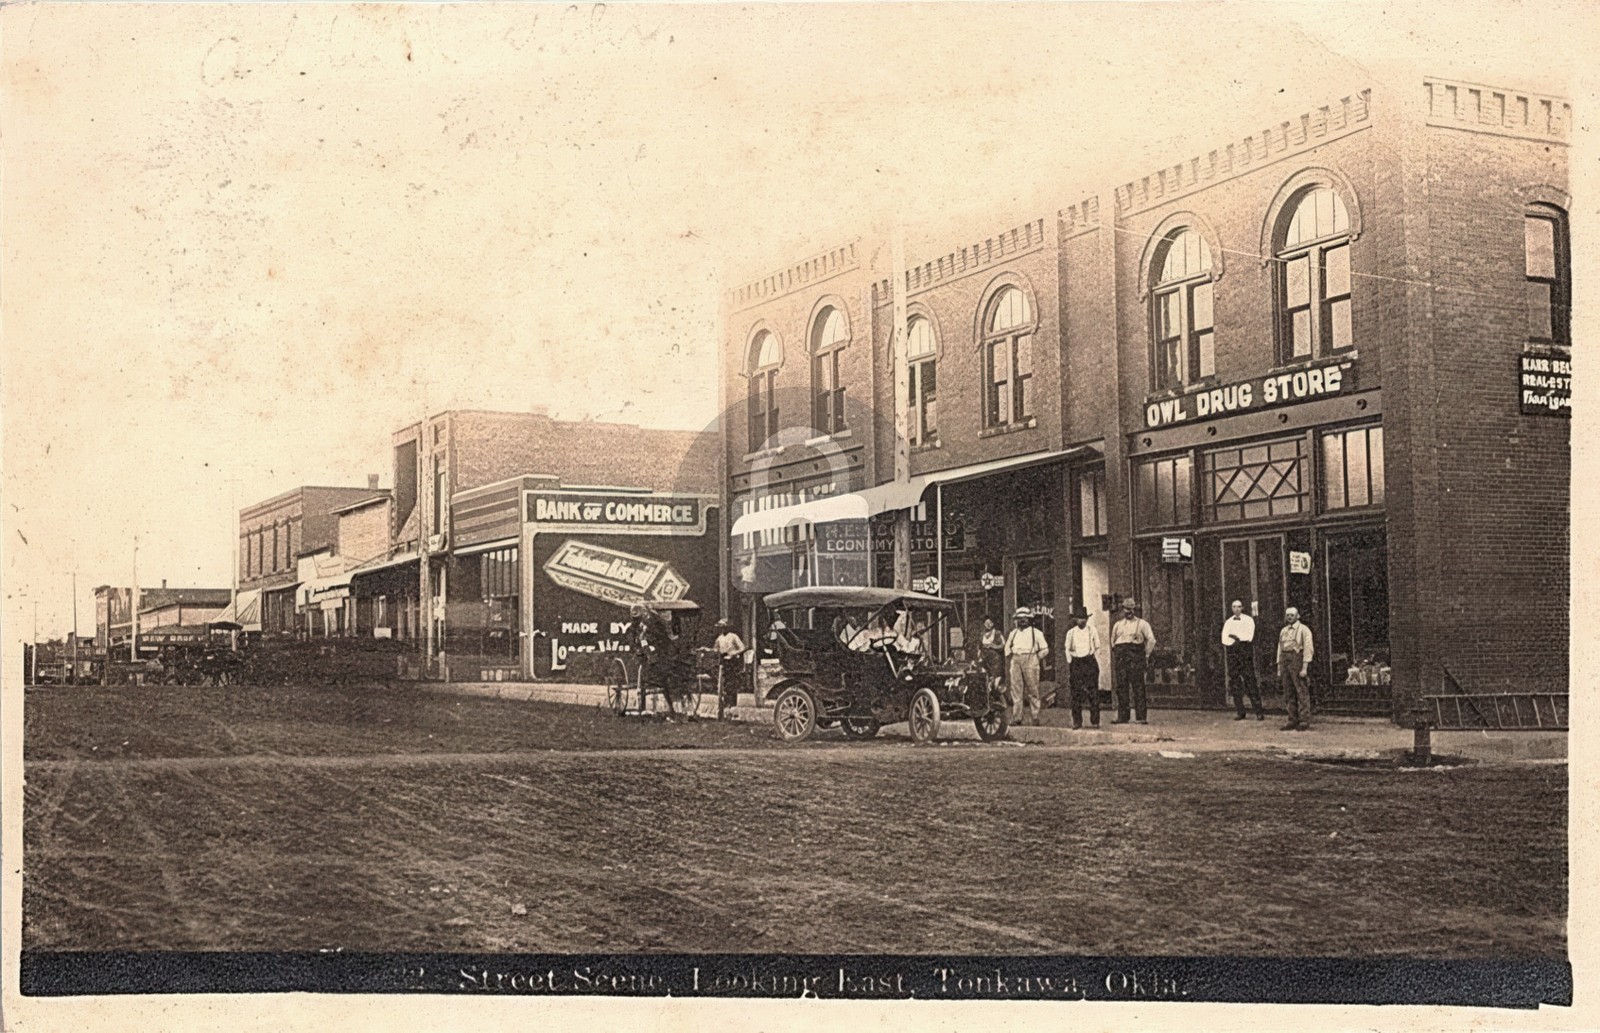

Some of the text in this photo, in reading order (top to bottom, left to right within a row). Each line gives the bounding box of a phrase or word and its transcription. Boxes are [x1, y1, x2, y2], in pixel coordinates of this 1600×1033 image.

[1147, 366, 1342, 427] OWL DRUG STORE
[536, 499, 582, 521] BANK
[605, 501, 693, 522] COMMERCE
[911, 537, 957, 550] STOE
[561, 622, 632, 634] MADE BY
